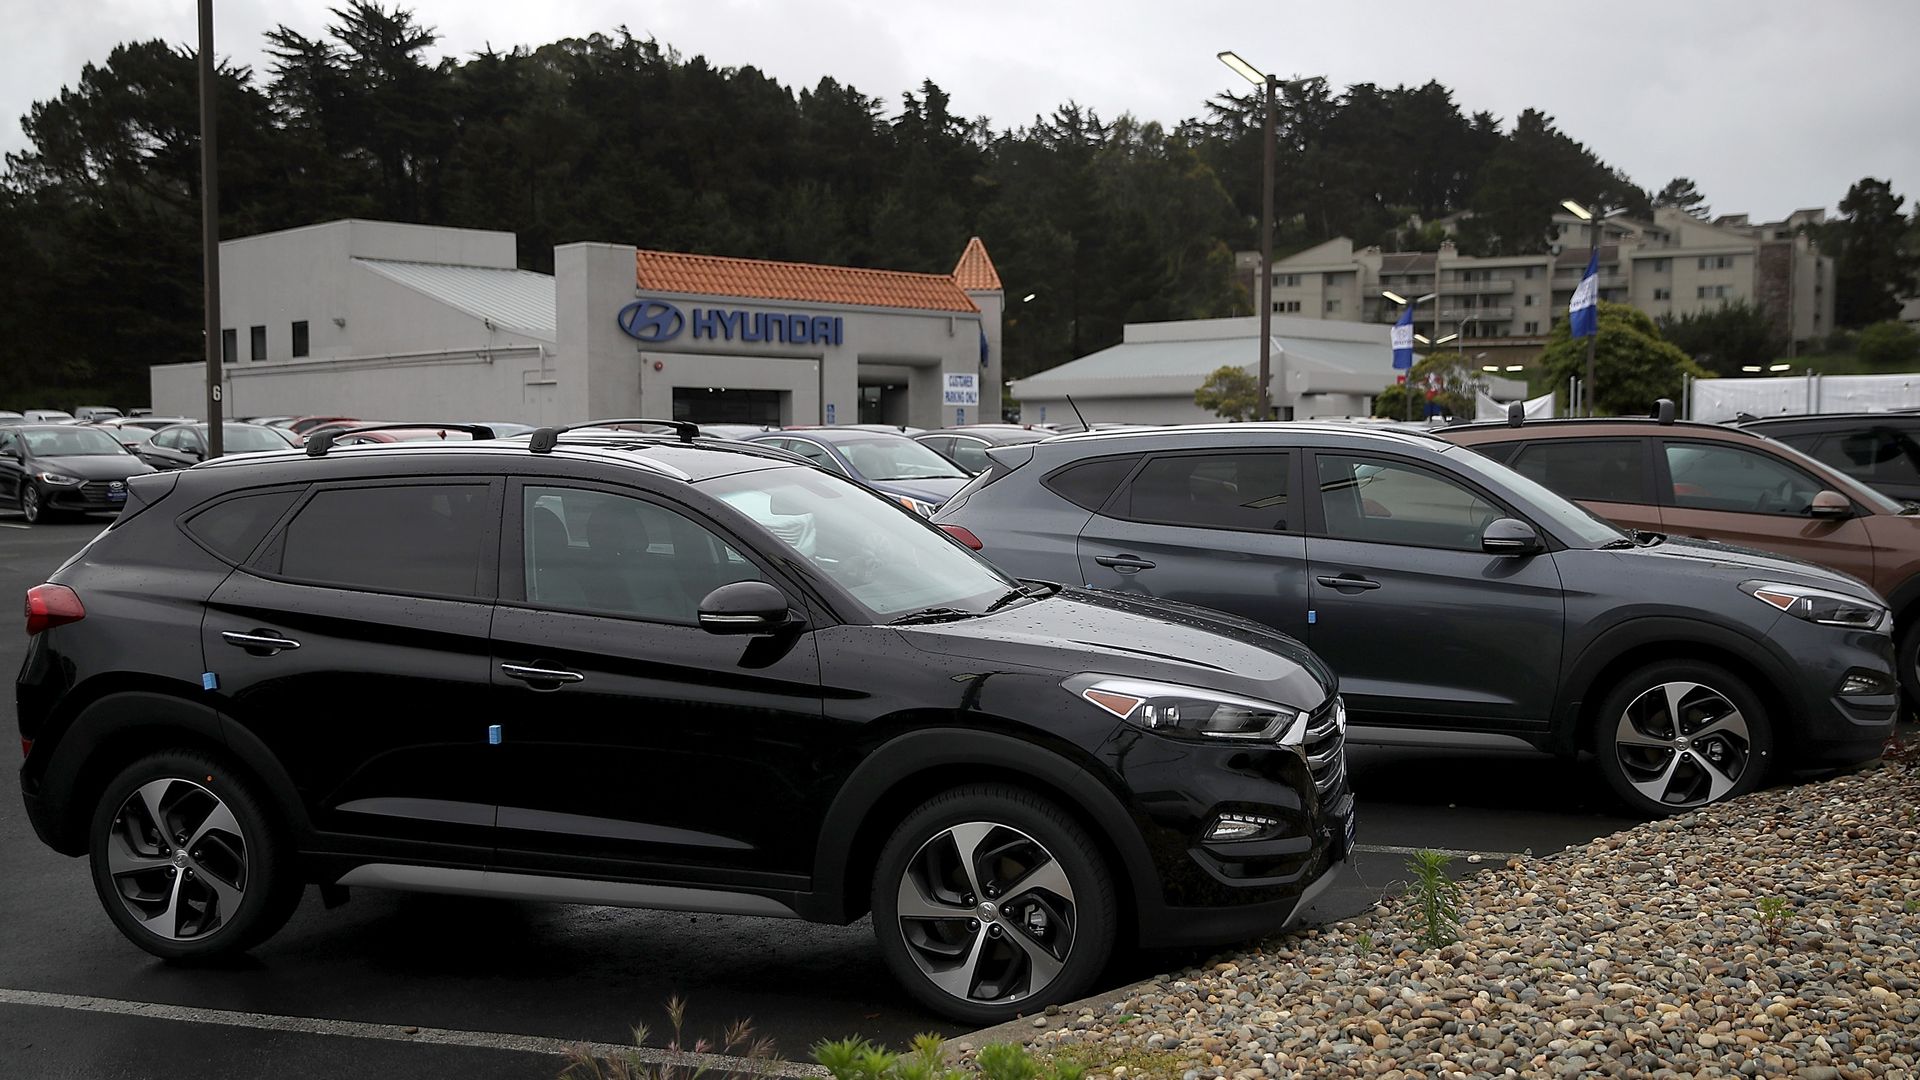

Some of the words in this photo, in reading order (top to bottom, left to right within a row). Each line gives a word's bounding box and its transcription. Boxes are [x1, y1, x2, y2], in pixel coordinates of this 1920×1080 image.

[693, 308, 844, 346] HYUNDAI
[948, 375, 973, 388] CUSTOMER
[212, 385, 221, 402] 6
[944, 391, 964, 403] PARKING
